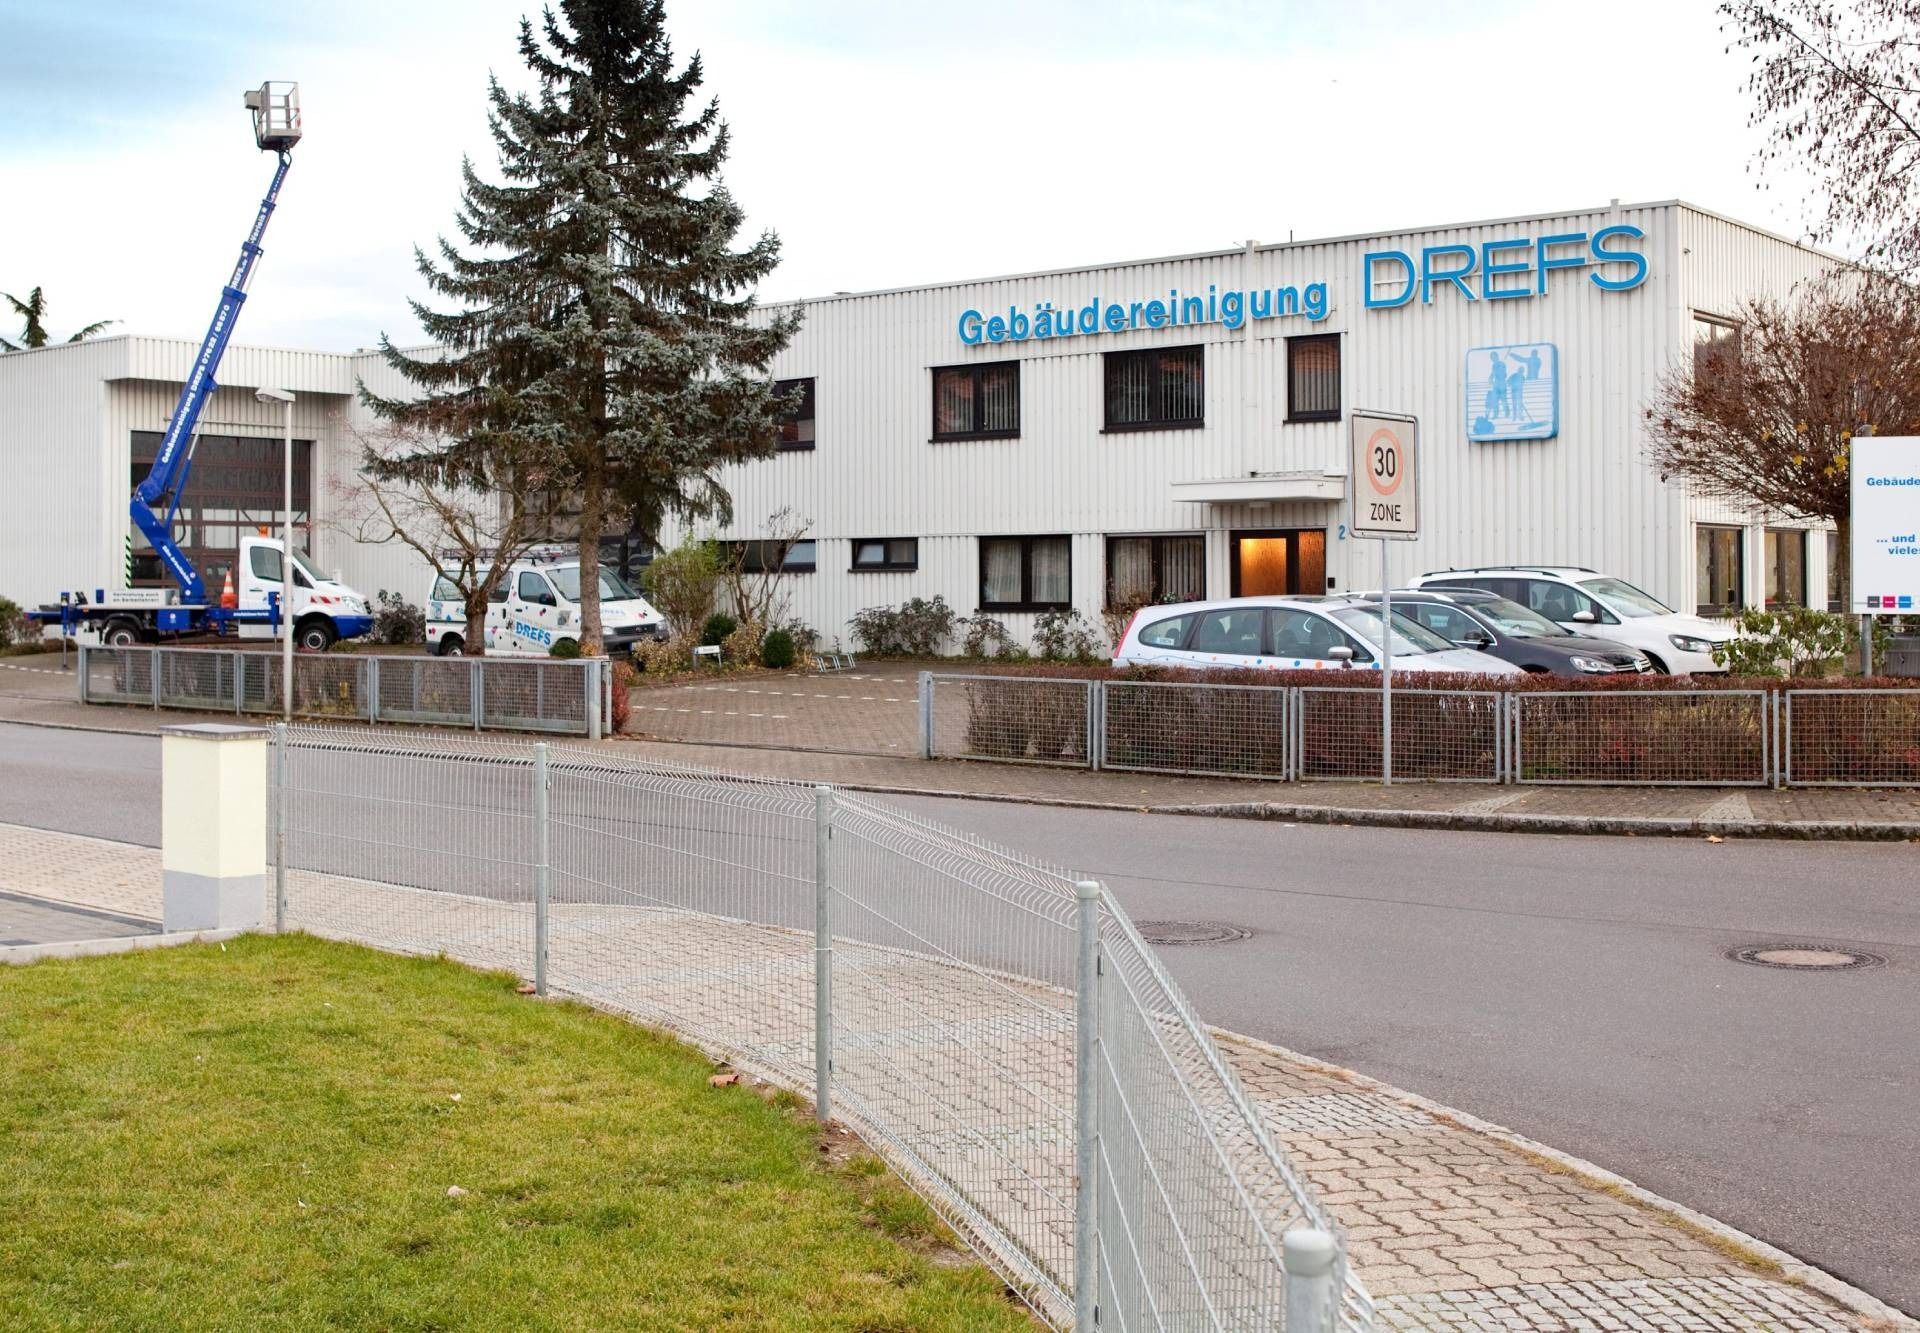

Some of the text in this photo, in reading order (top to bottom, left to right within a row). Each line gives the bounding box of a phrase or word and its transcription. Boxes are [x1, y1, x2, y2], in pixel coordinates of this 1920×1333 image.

[958, 224, 1650, 345] Gebäudereinigung DREFS
[161, 391, 196, 464] Gebäudereinigung
[1374, 446, 1396, 477] 30
[1370, 503, 1402, 522] ZONE
[1338, 525, 1346, 540] 2
[1892, 533, 1916, 543] und
[515, 620, 552, 645] DREFS
